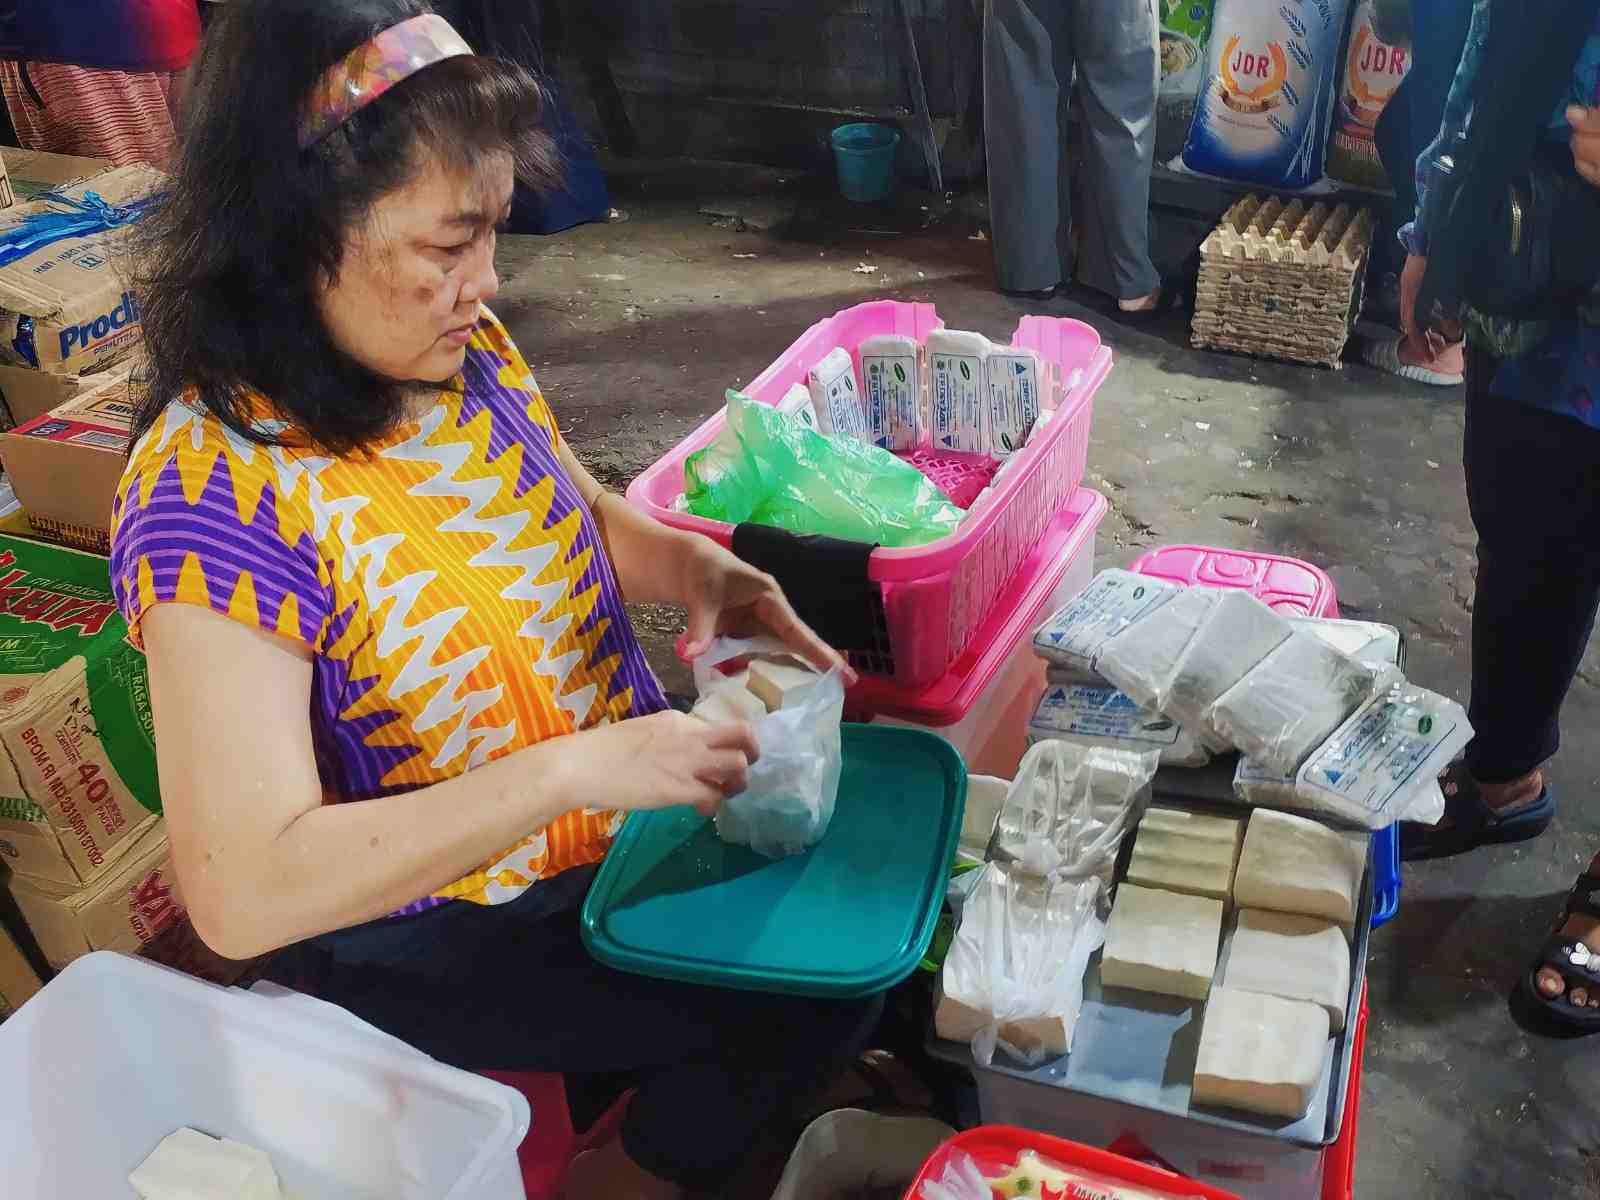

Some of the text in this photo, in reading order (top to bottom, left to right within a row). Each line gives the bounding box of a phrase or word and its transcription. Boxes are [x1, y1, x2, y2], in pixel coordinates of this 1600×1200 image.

[1232, 51, 1271, 79] JDR
[1360, 45, 1408, 76] JDR
[132, 674, 147, 712] RASA
[21, 727, 51, 768] BPOM
[78, 759, 109, 803] 40
